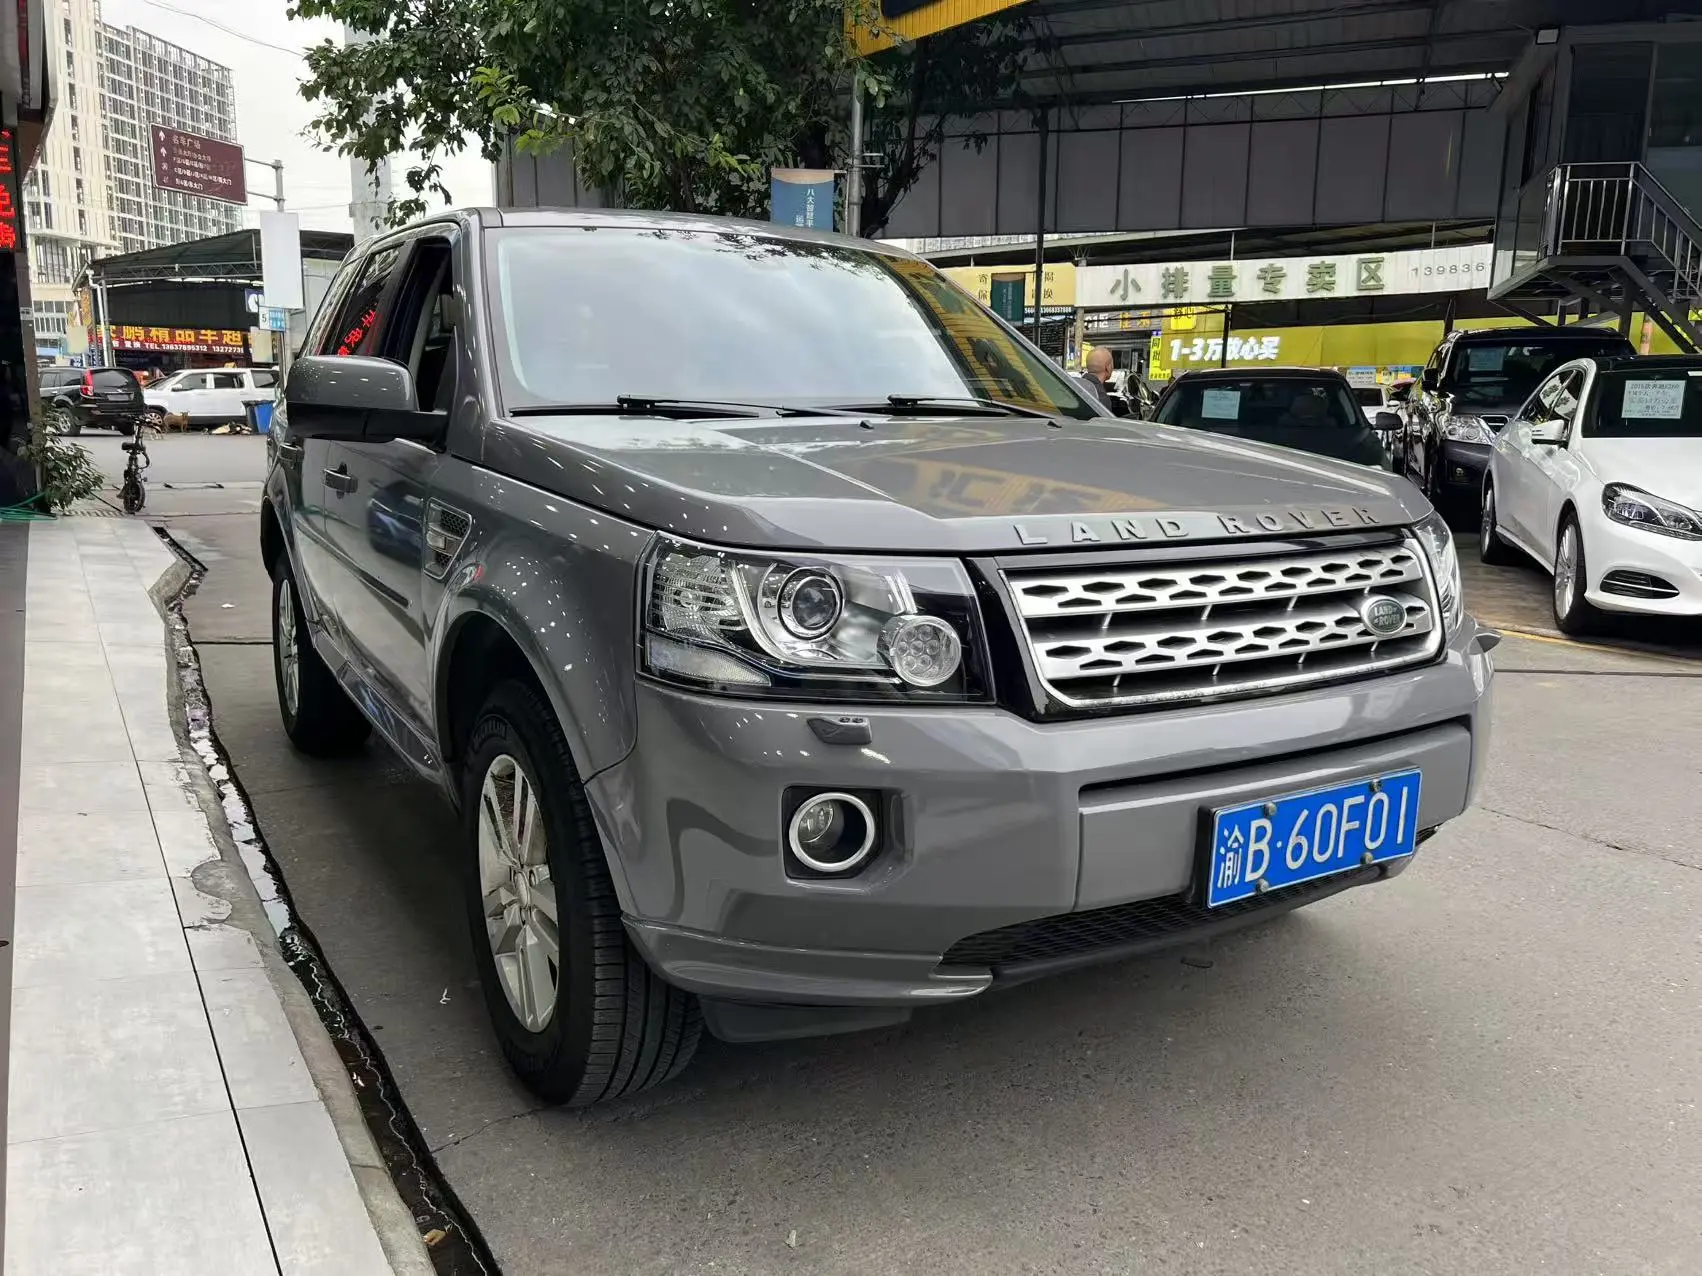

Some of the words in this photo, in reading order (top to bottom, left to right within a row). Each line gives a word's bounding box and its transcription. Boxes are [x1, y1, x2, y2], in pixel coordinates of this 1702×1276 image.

[1110, 257, 1385, 299] 小排量专卖区
[1169, 335, 1281, 362] 1-3万放心买
[1013, 516, 1189, 545] LAND
[1217, 506, 1381, 534] ROVER
